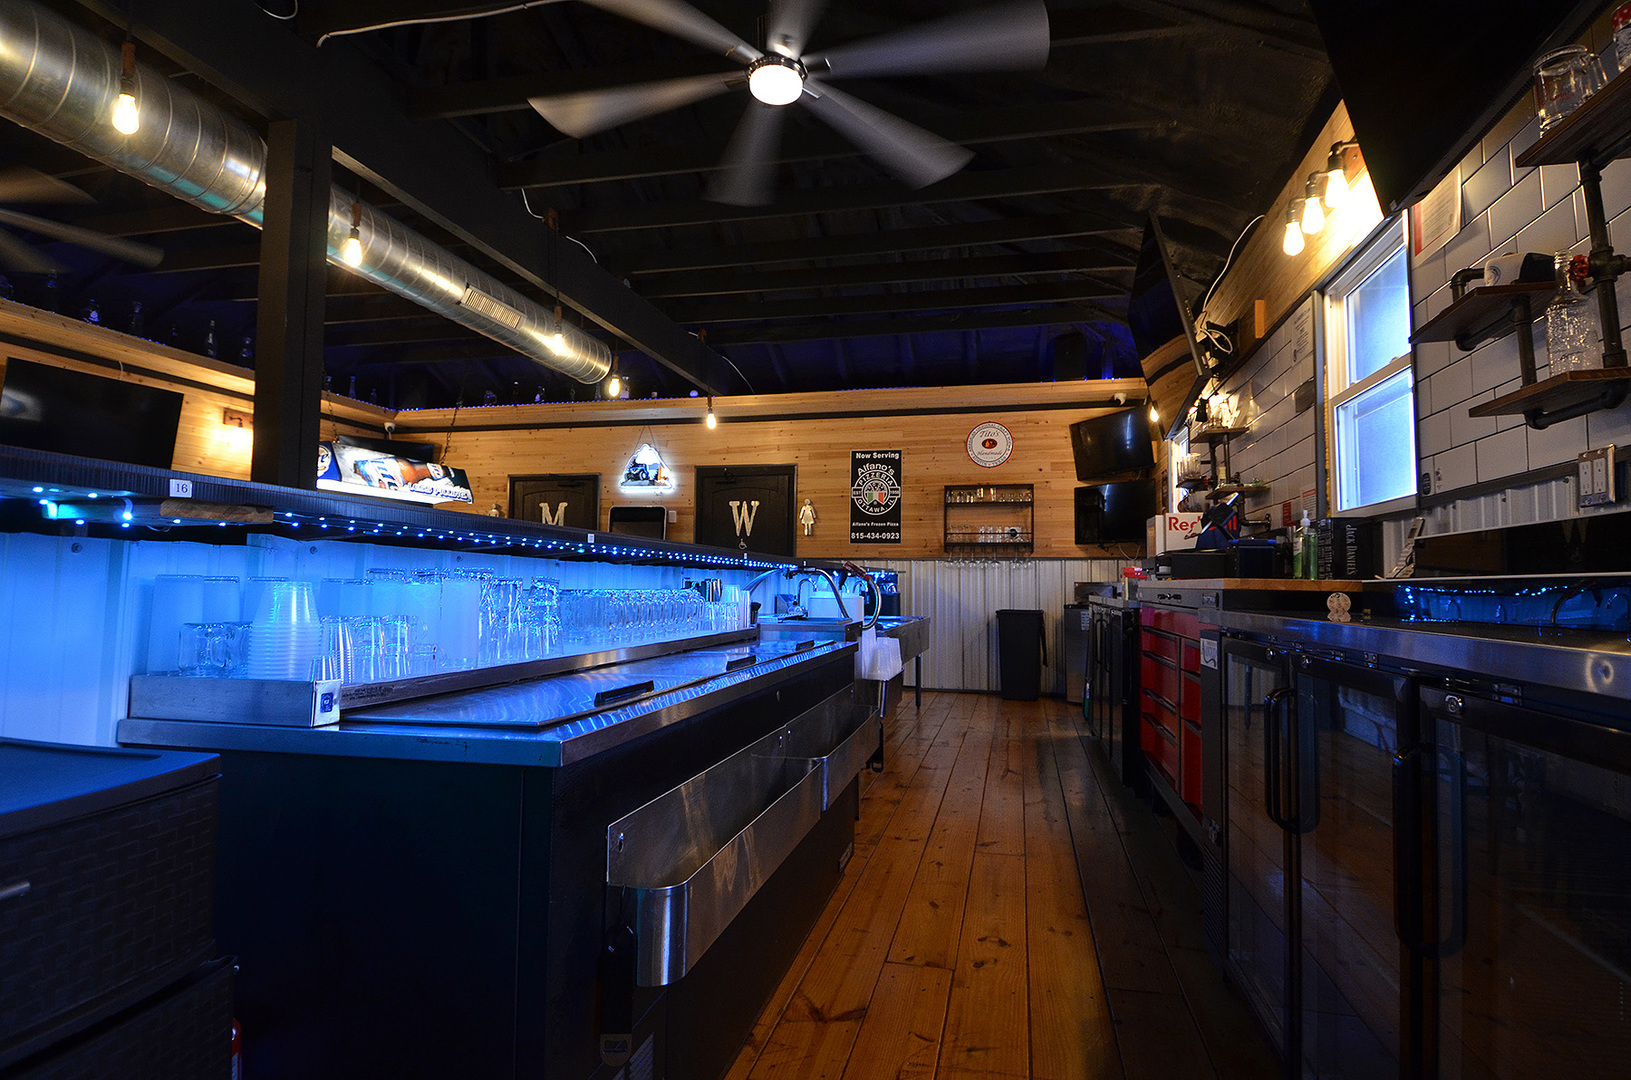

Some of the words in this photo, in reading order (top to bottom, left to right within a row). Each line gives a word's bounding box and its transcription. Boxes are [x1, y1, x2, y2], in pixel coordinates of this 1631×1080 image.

[980, 430, 1000, 438] Tito's
[872, 452, 900, 460] Serving
[857, 463, 895, 476] Alfano's
[858, 472, 893, 486] PIZZERIA
[176, 483, 188, 493] 16
[858, 499, 888, 513] OTTAWA,
[539, 502, 568, 526] M
[728, 501, 760, 537] W
[851, 532, 900, 540] 815-434-0923
[1345, 524, 1357, 544] JACK
[1346, 545, 1358, 576] DANIEL'S
